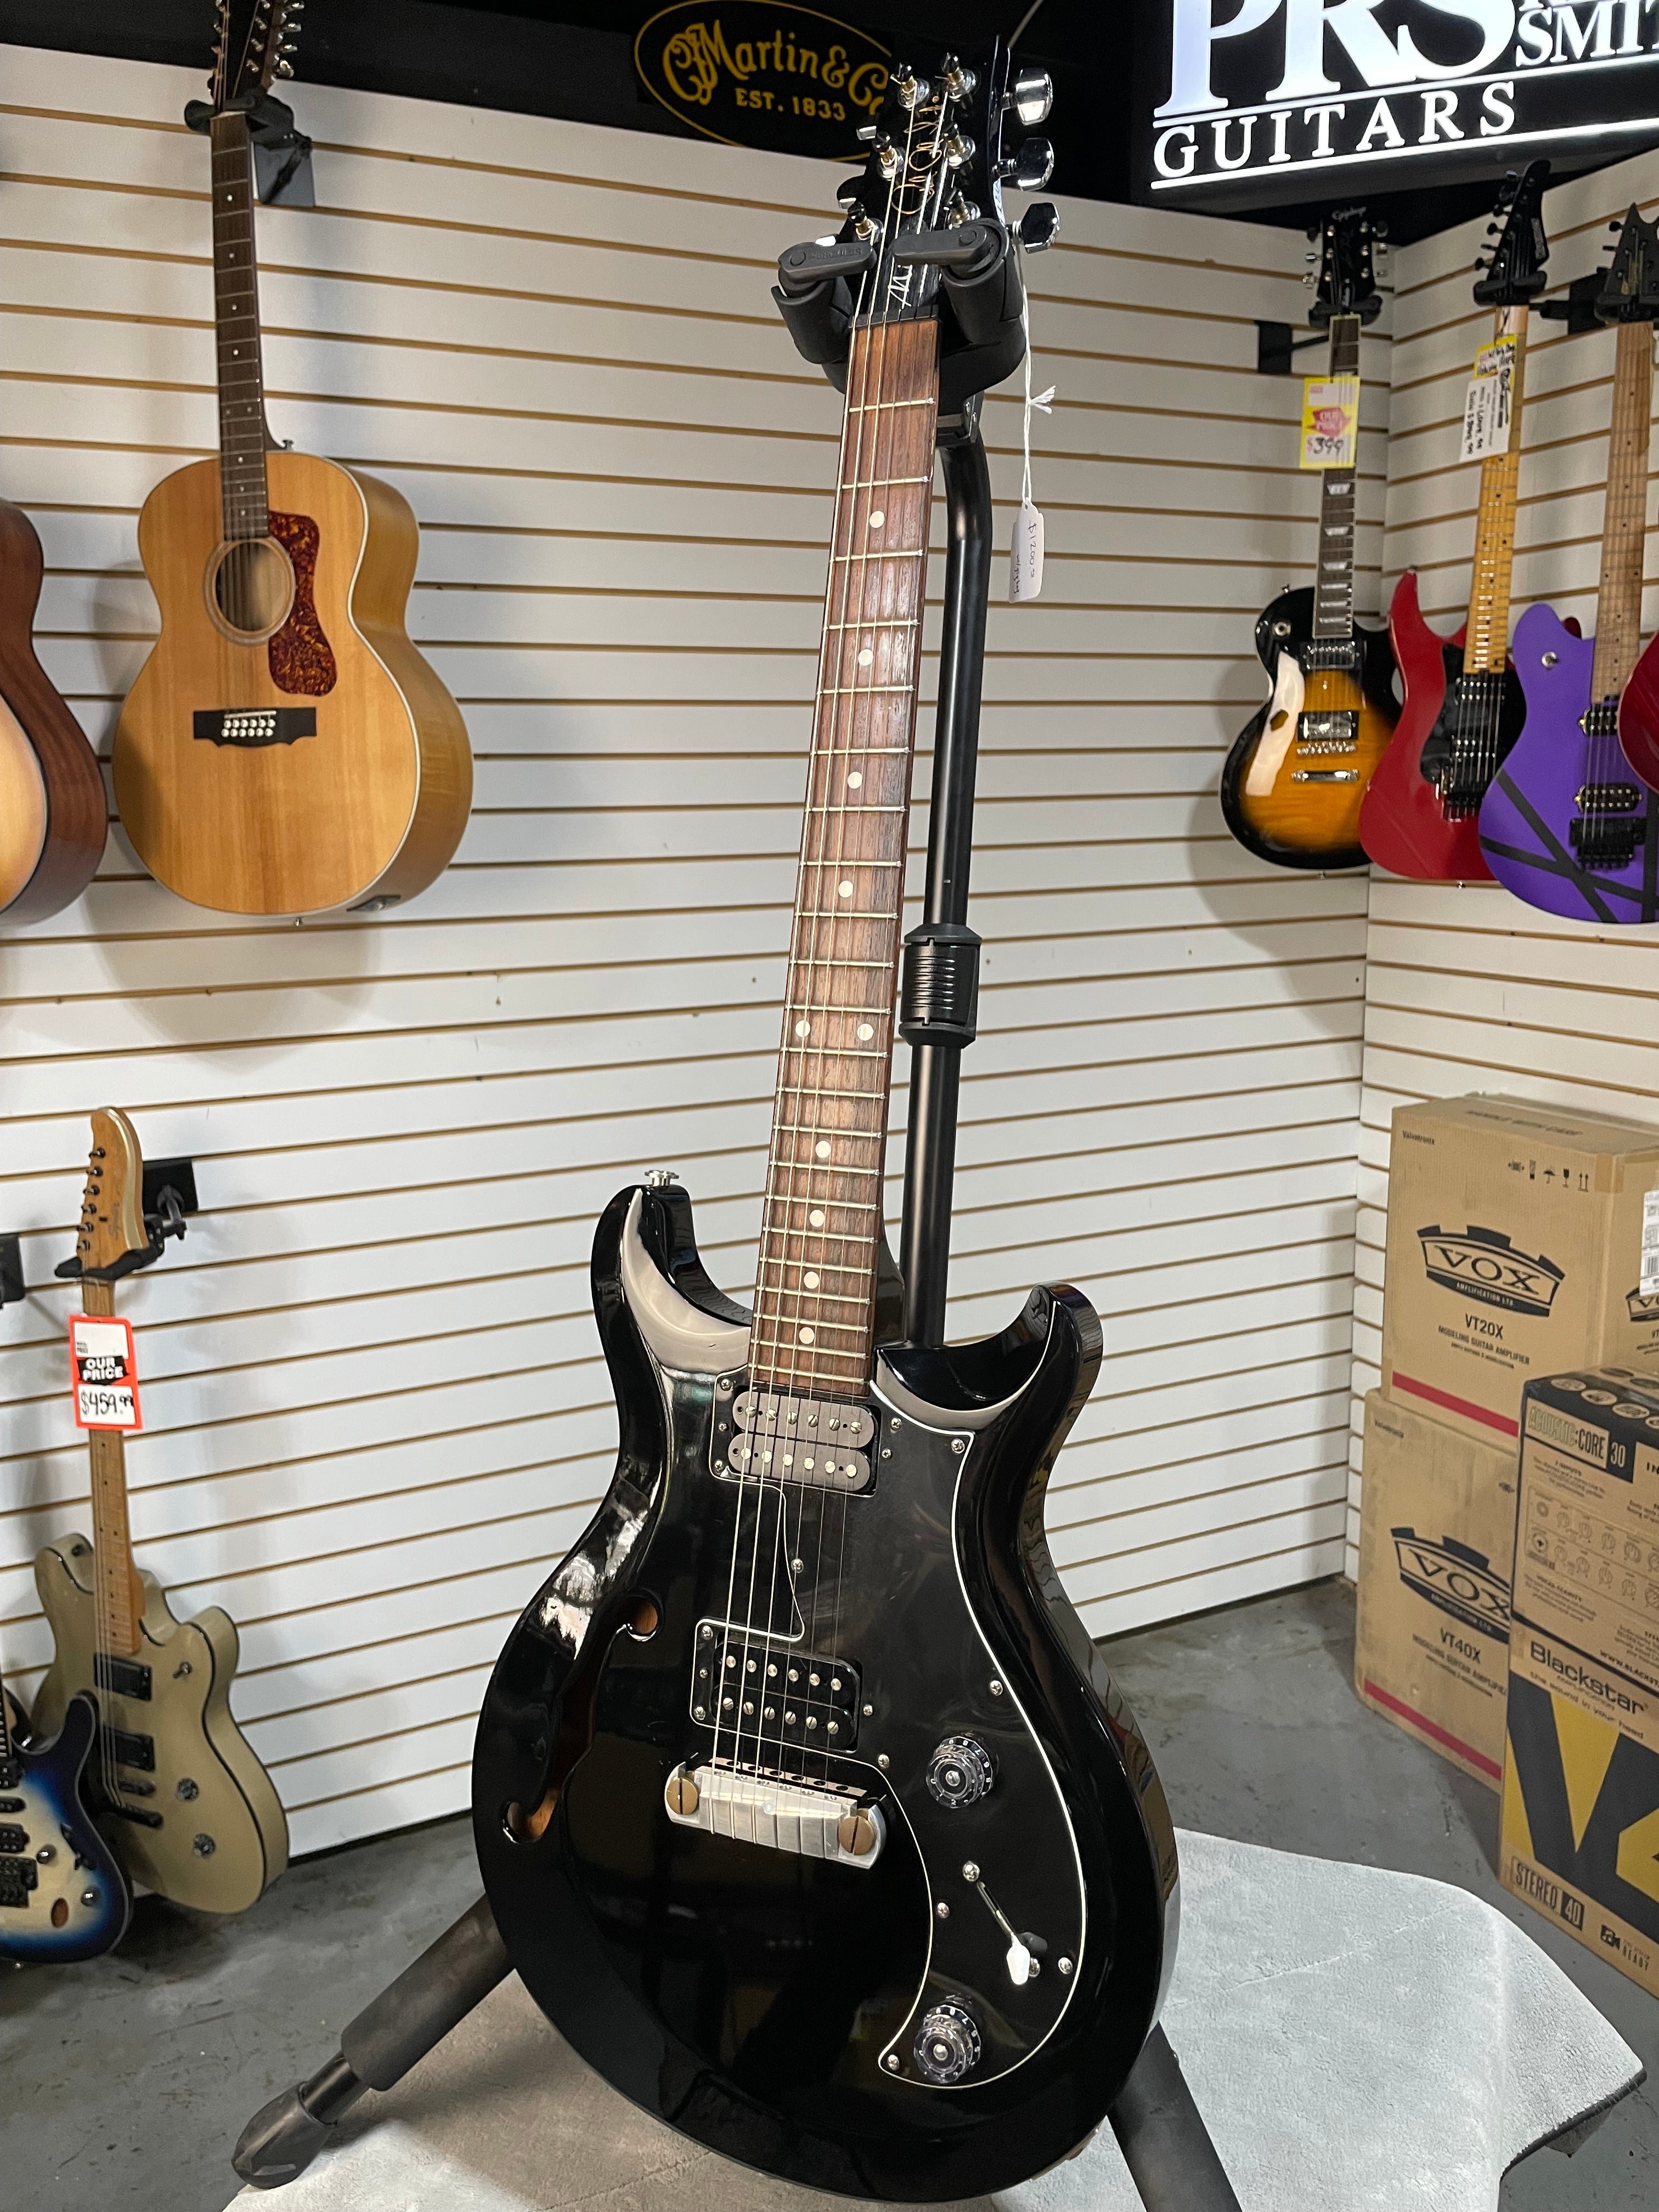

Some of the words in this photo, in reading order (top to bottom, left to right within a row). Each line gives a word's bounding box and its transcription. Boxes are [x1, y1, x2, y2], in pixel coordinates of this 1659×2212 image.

[735, 88, 783, 112] EST.
[792, 97, 845, 121] 1833
[1153, 81, 1516, 179] GUITARS
[1434, 1245, 1540, 1295] VOX
[1465, 1313, 1503, 1340] VT20X
[83, 1366, 124, 1381] PRICE
[86, 1357, 116, 1369] OUR
[1610, 1442, 1627, 1468] 30
[1408, 1548, 1510, 1621] VOX
[1440, 1627, 1481, 1664] VT40X
[1531, 1641, 1645, 1714] Blackstar
[1515, 1862, 1559, 1910] STEREO
[1565, 1897, 1582, 1926] 40
